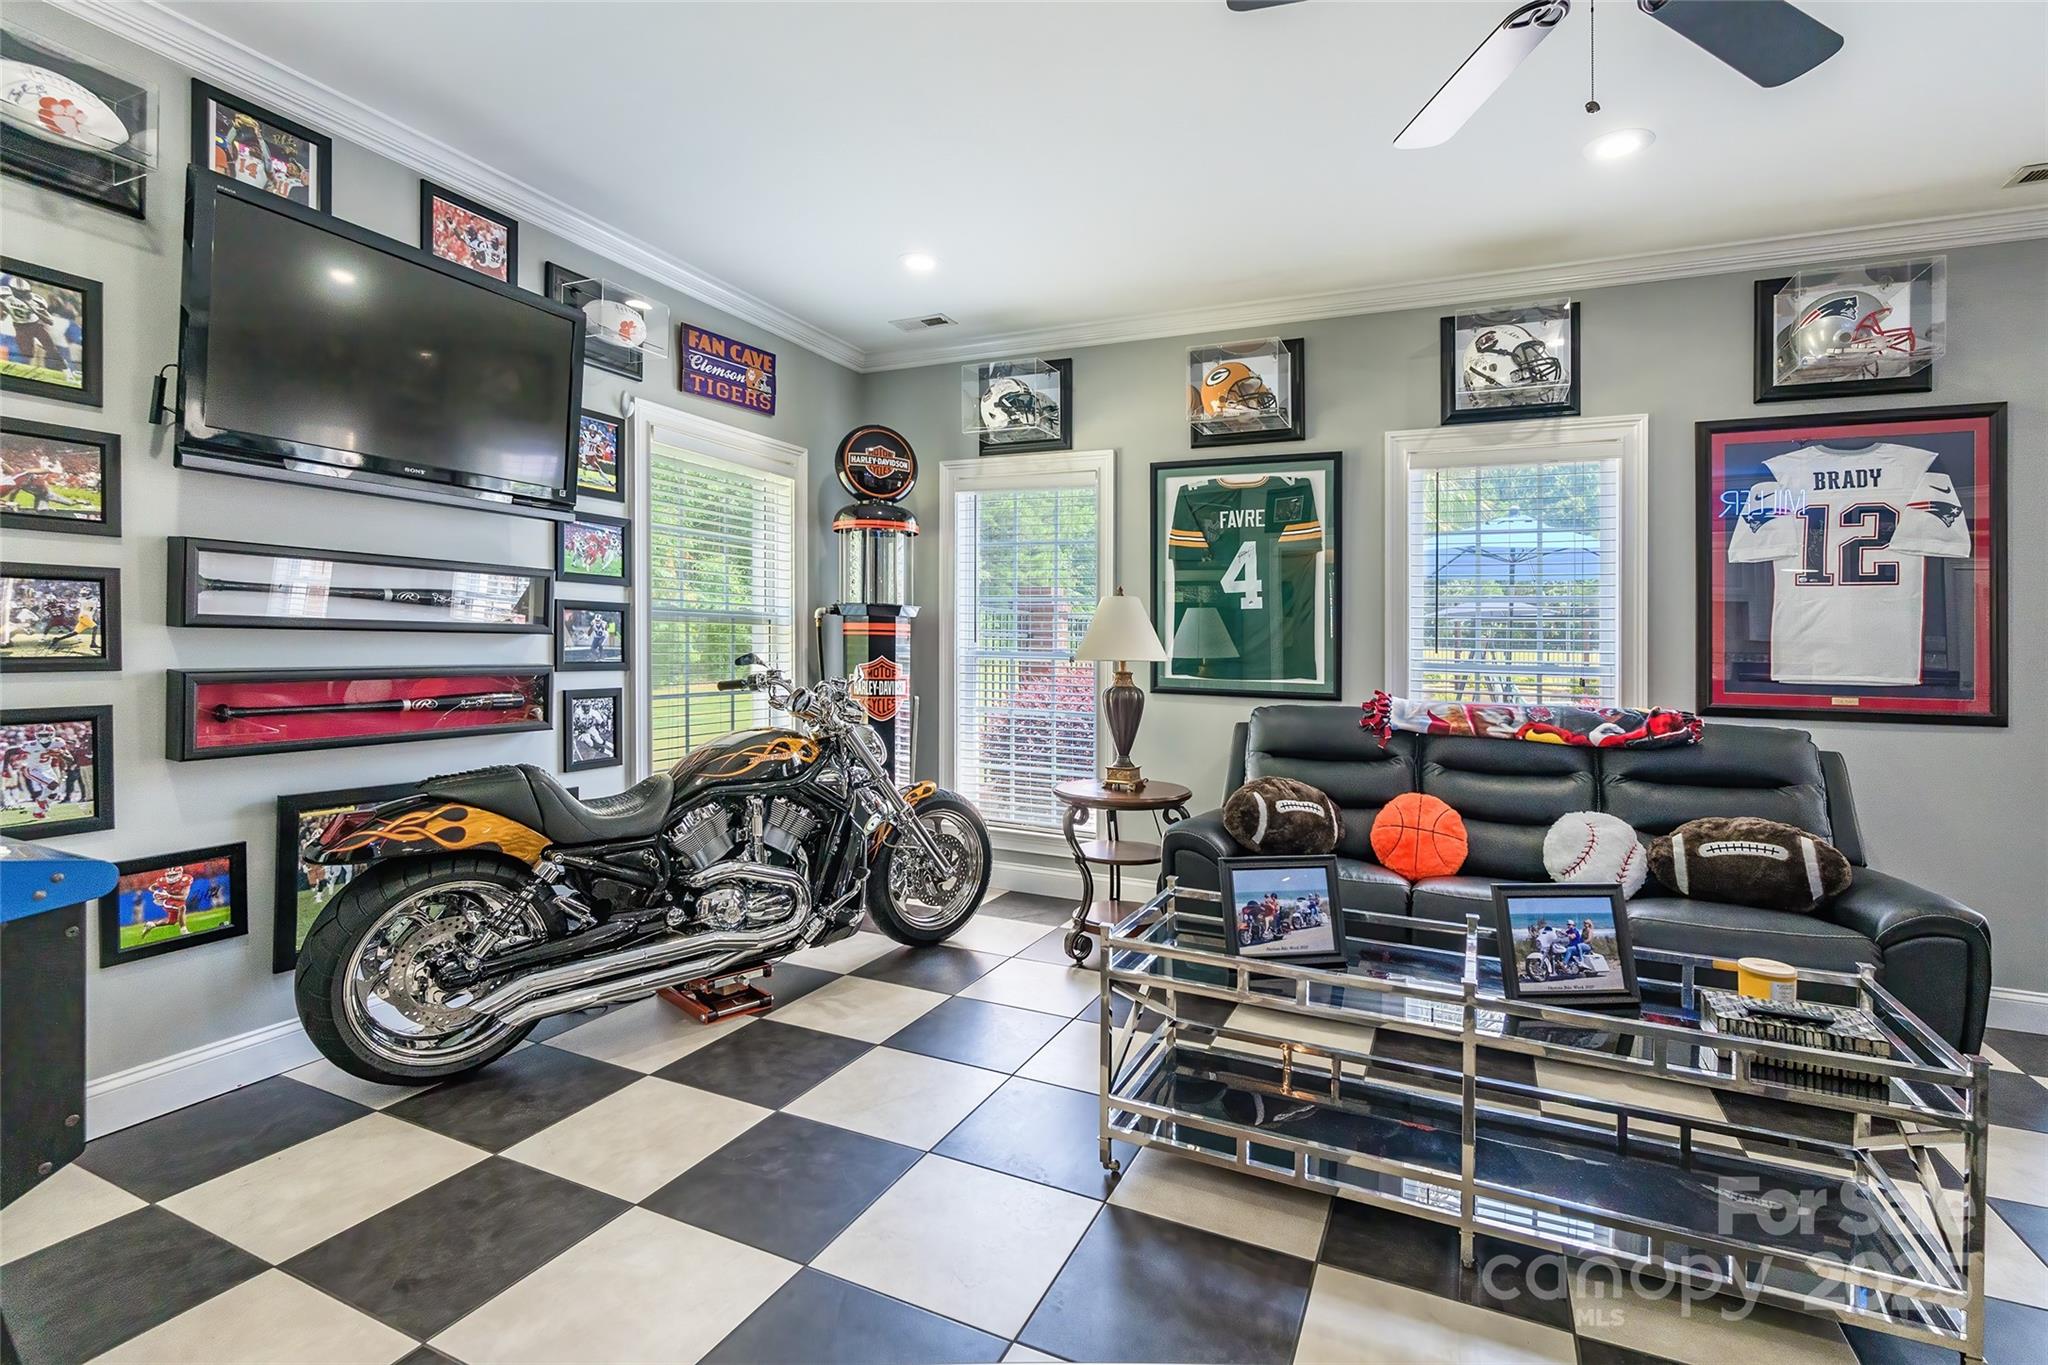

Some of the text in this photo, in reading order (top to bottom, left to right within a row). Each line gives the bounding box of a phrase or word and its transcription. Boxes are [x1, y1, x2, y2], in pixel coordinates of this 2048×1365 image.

[688, 329, 773, 373] FAN CAVE
[688, 354, 747, 384] Clemson
[690, 374, 772, 411] TIGERS
[404, 466, 426, 475] SONY
[851, 455, 908, 469] HARLEY-DAVIDSON
[1812, 468, 1882, 491] BRADY
[1219, 508, 1266, 529] FAVRE
[1795, 502, 1900, 587] 12
[1220, 540, 1264, 610] 4
